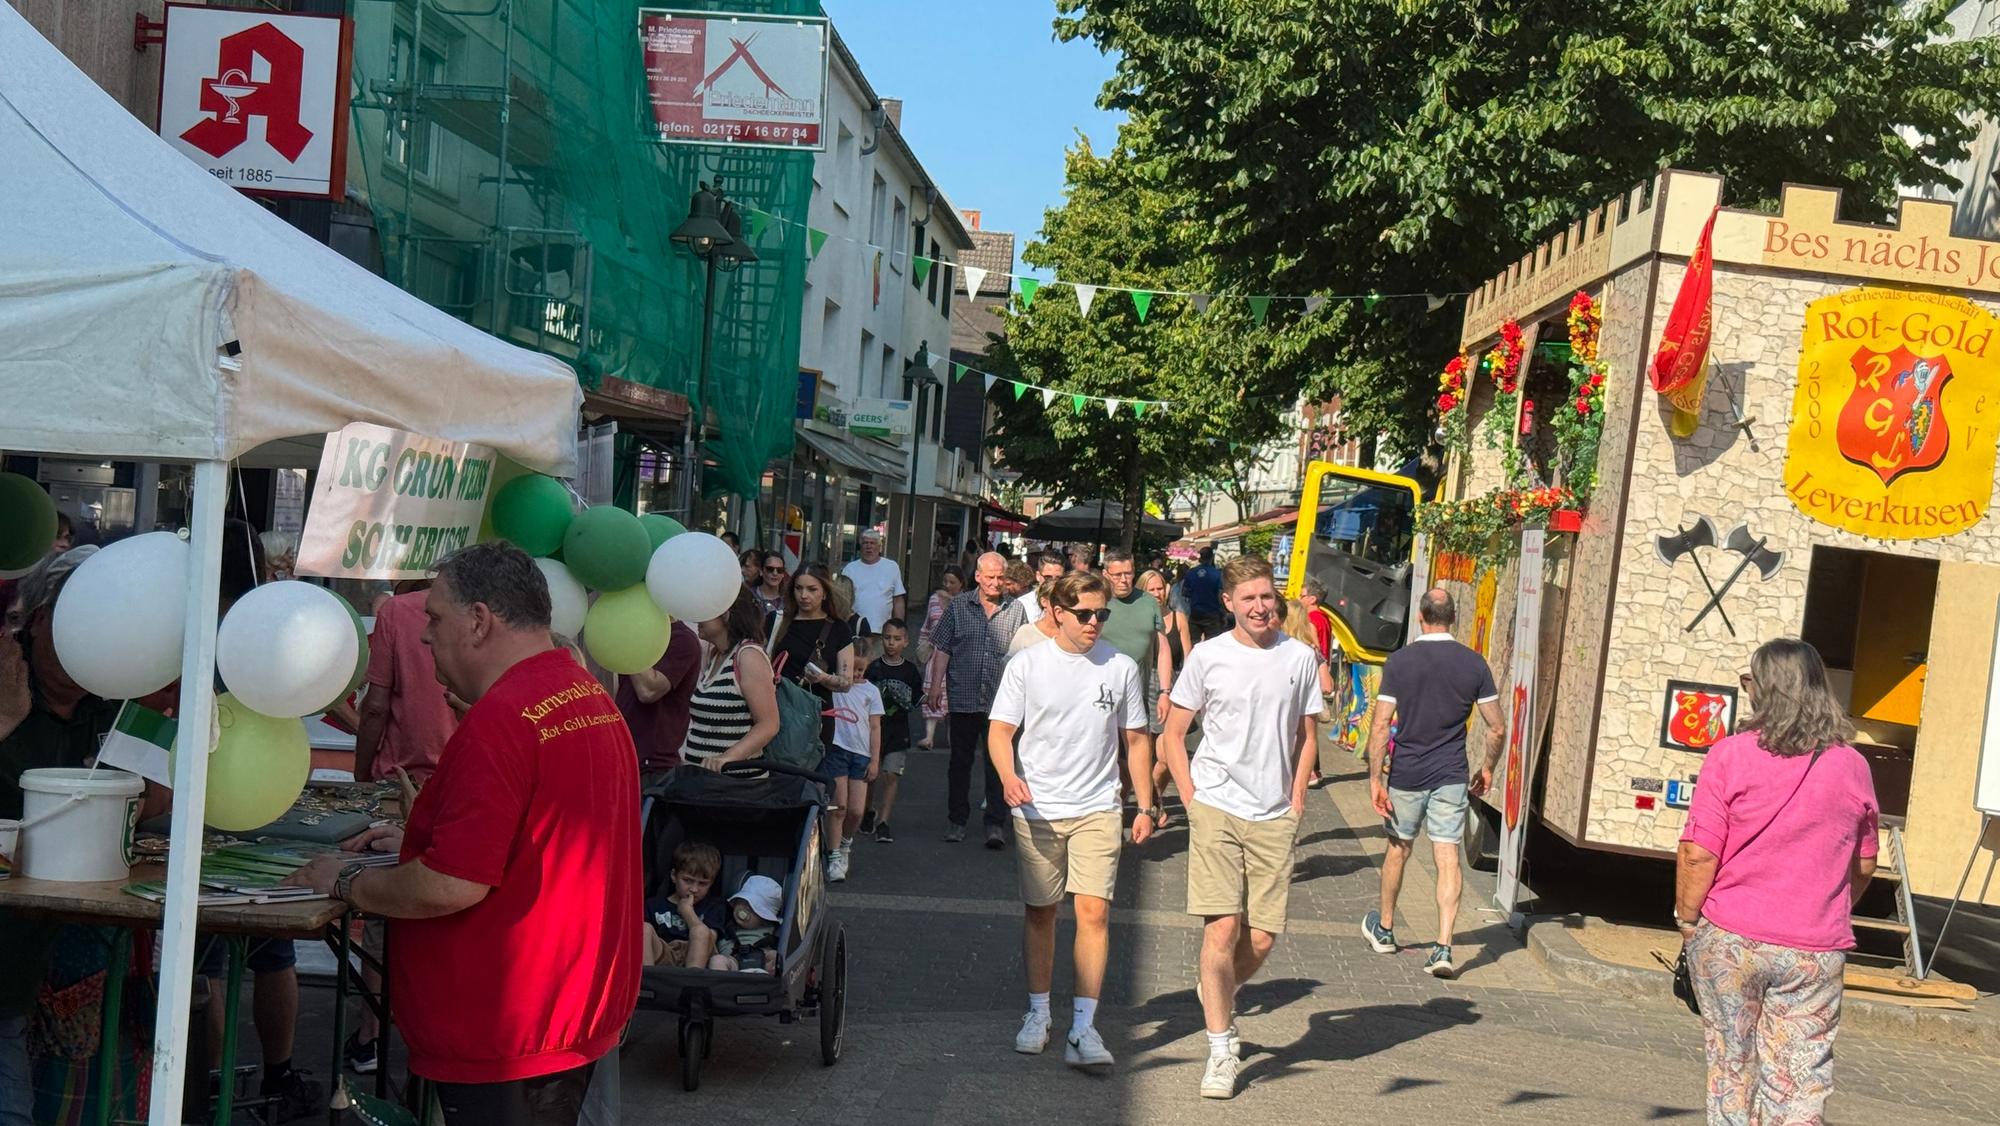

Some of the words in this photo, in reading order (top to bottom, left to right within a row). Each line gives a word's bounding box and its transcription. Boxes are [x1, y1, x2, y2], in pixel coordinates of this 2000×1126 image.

[655, 121, 694, 133] lefon:
[703, 123, 741, 136] 02175
[744, 125, 751, 136] /
[755, 126, 769, 135] 16
[773, 127, 788, 137] 87
[792, 128, 807, 139] 84
[208, 166, 233, 180] seit
[239, 168, 273, 182] 1885
[1763, 220, 1829, 259] Bes
[1843, 232, 1961, 274] nächs
[853, 413, 882, 423] GEERS
[339, 437, 391, 491] KG
[393, 443, 458, 500] GRÜN
[1788, 472, 1982, 526] Leverkusen
